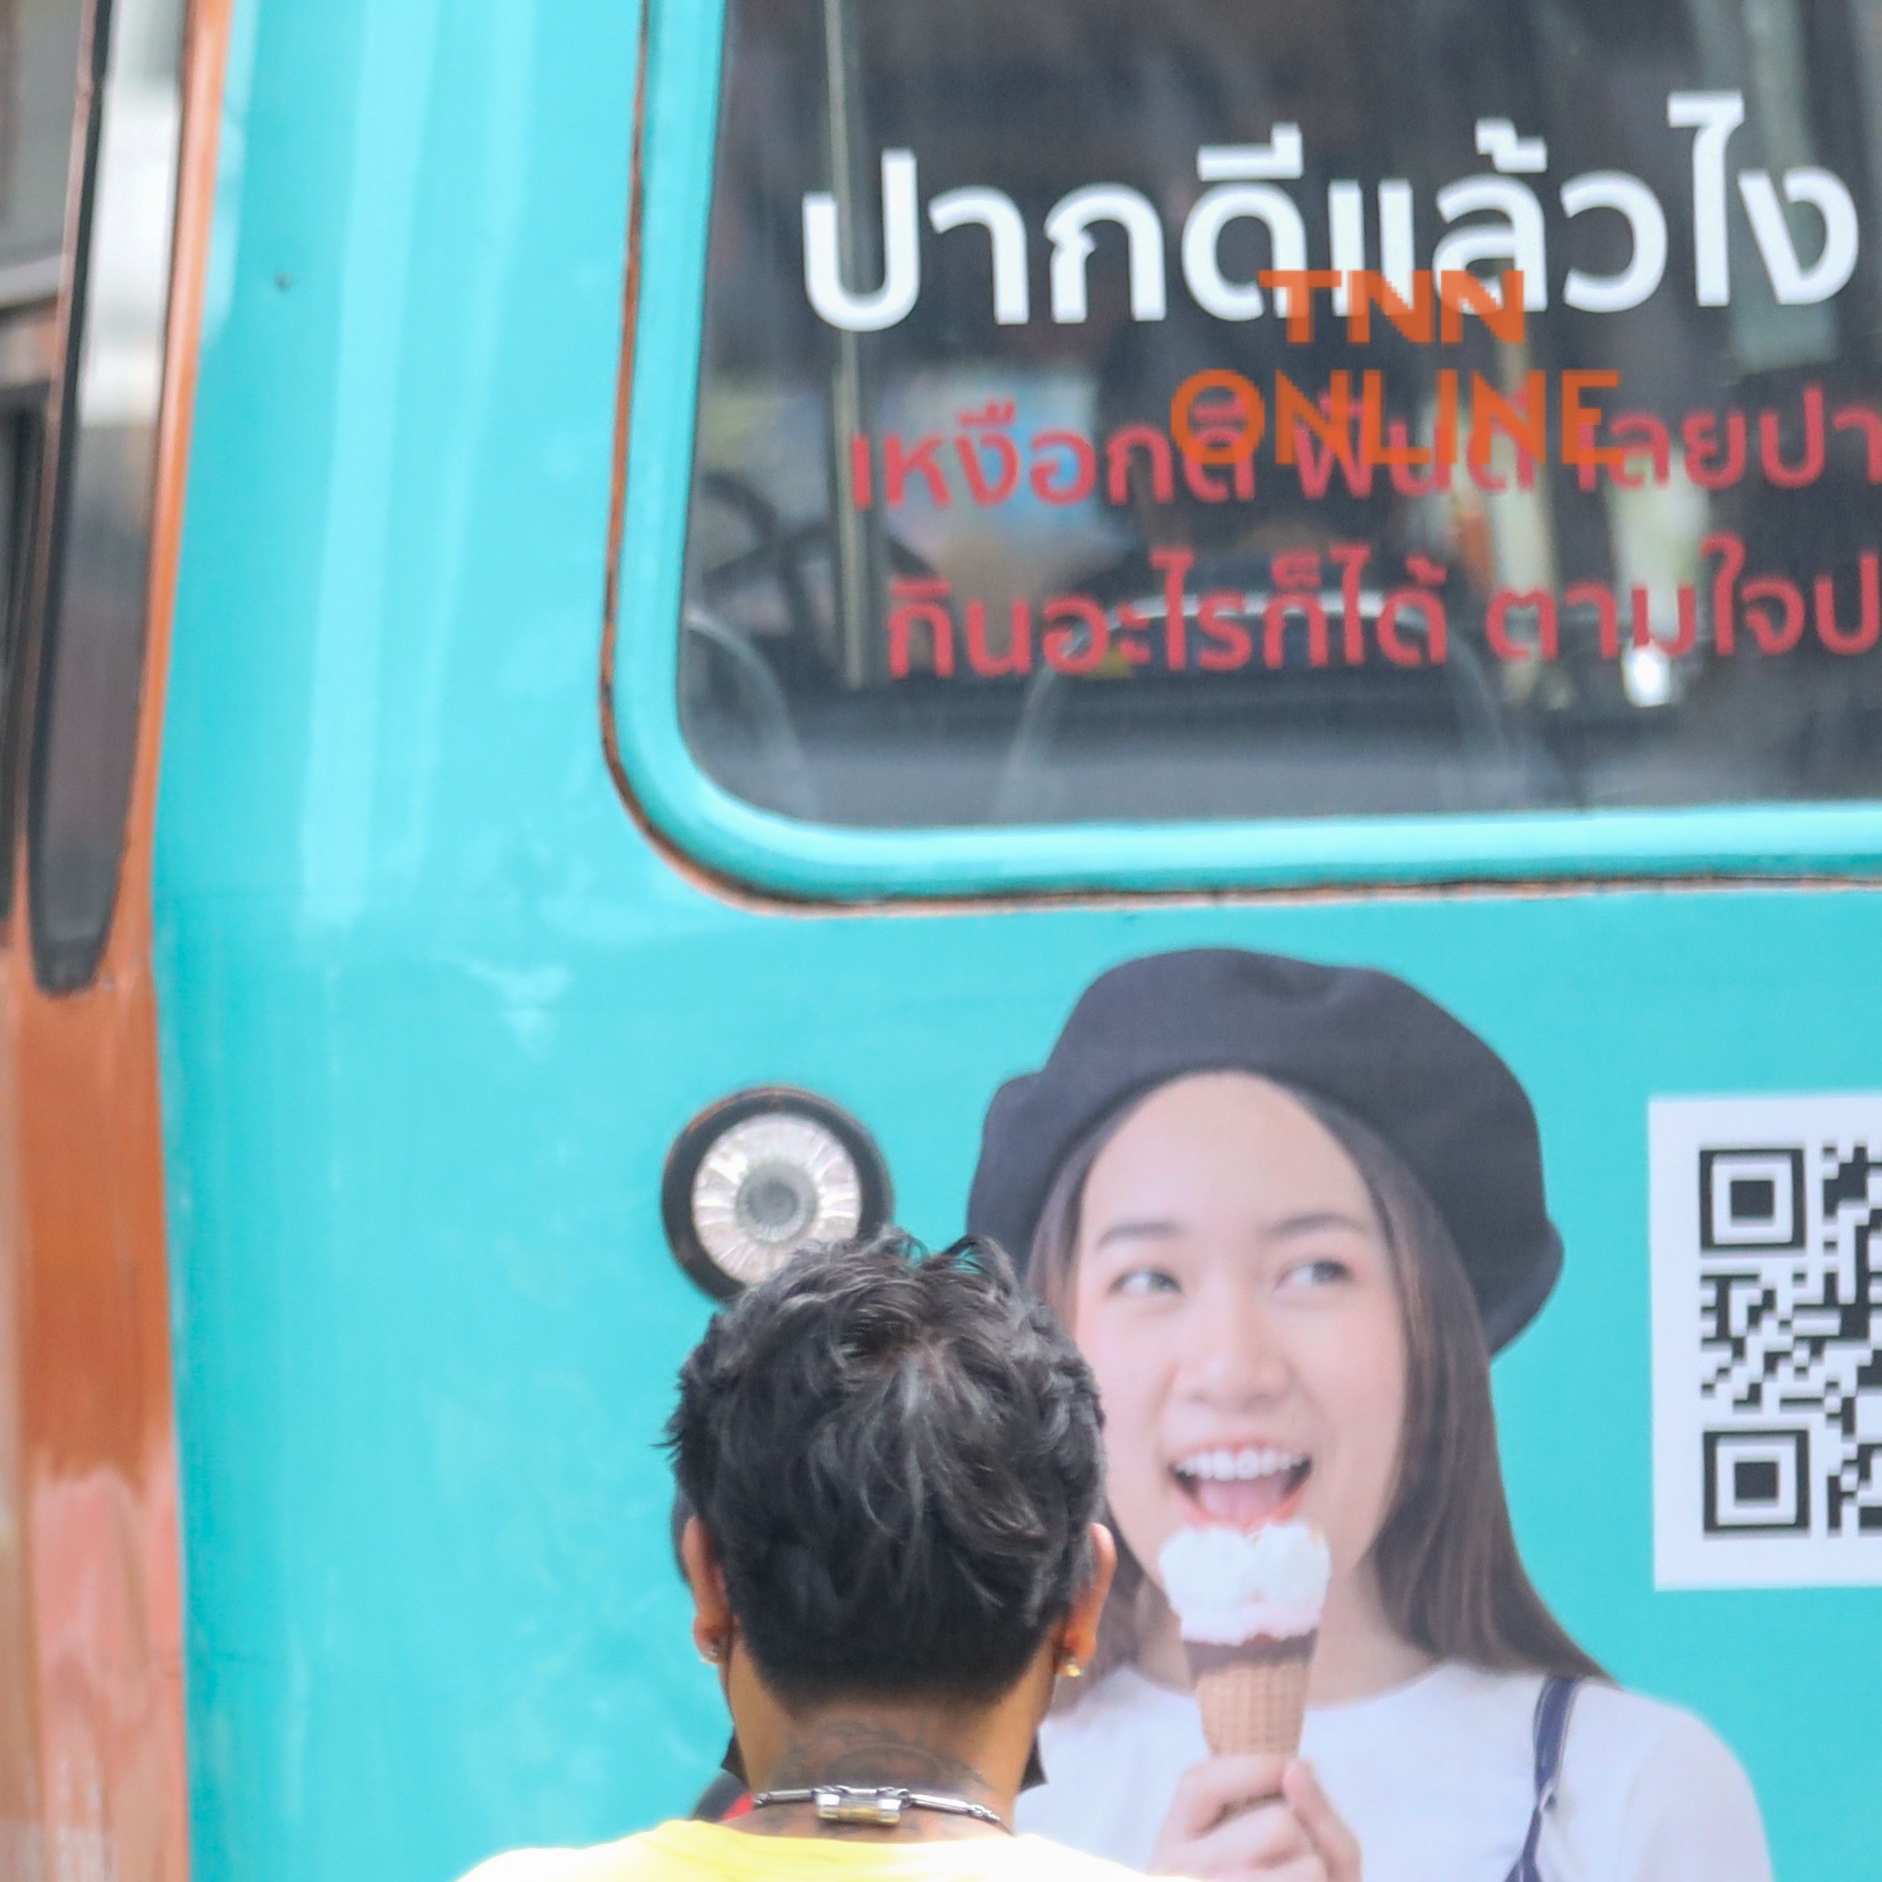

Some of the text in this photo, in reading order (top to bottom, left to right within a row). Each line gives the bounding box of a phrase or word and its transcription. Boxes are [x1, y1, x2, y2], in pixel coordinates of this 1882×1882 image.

[801, 88, 1861, 333] ปากดีแล้วไง
